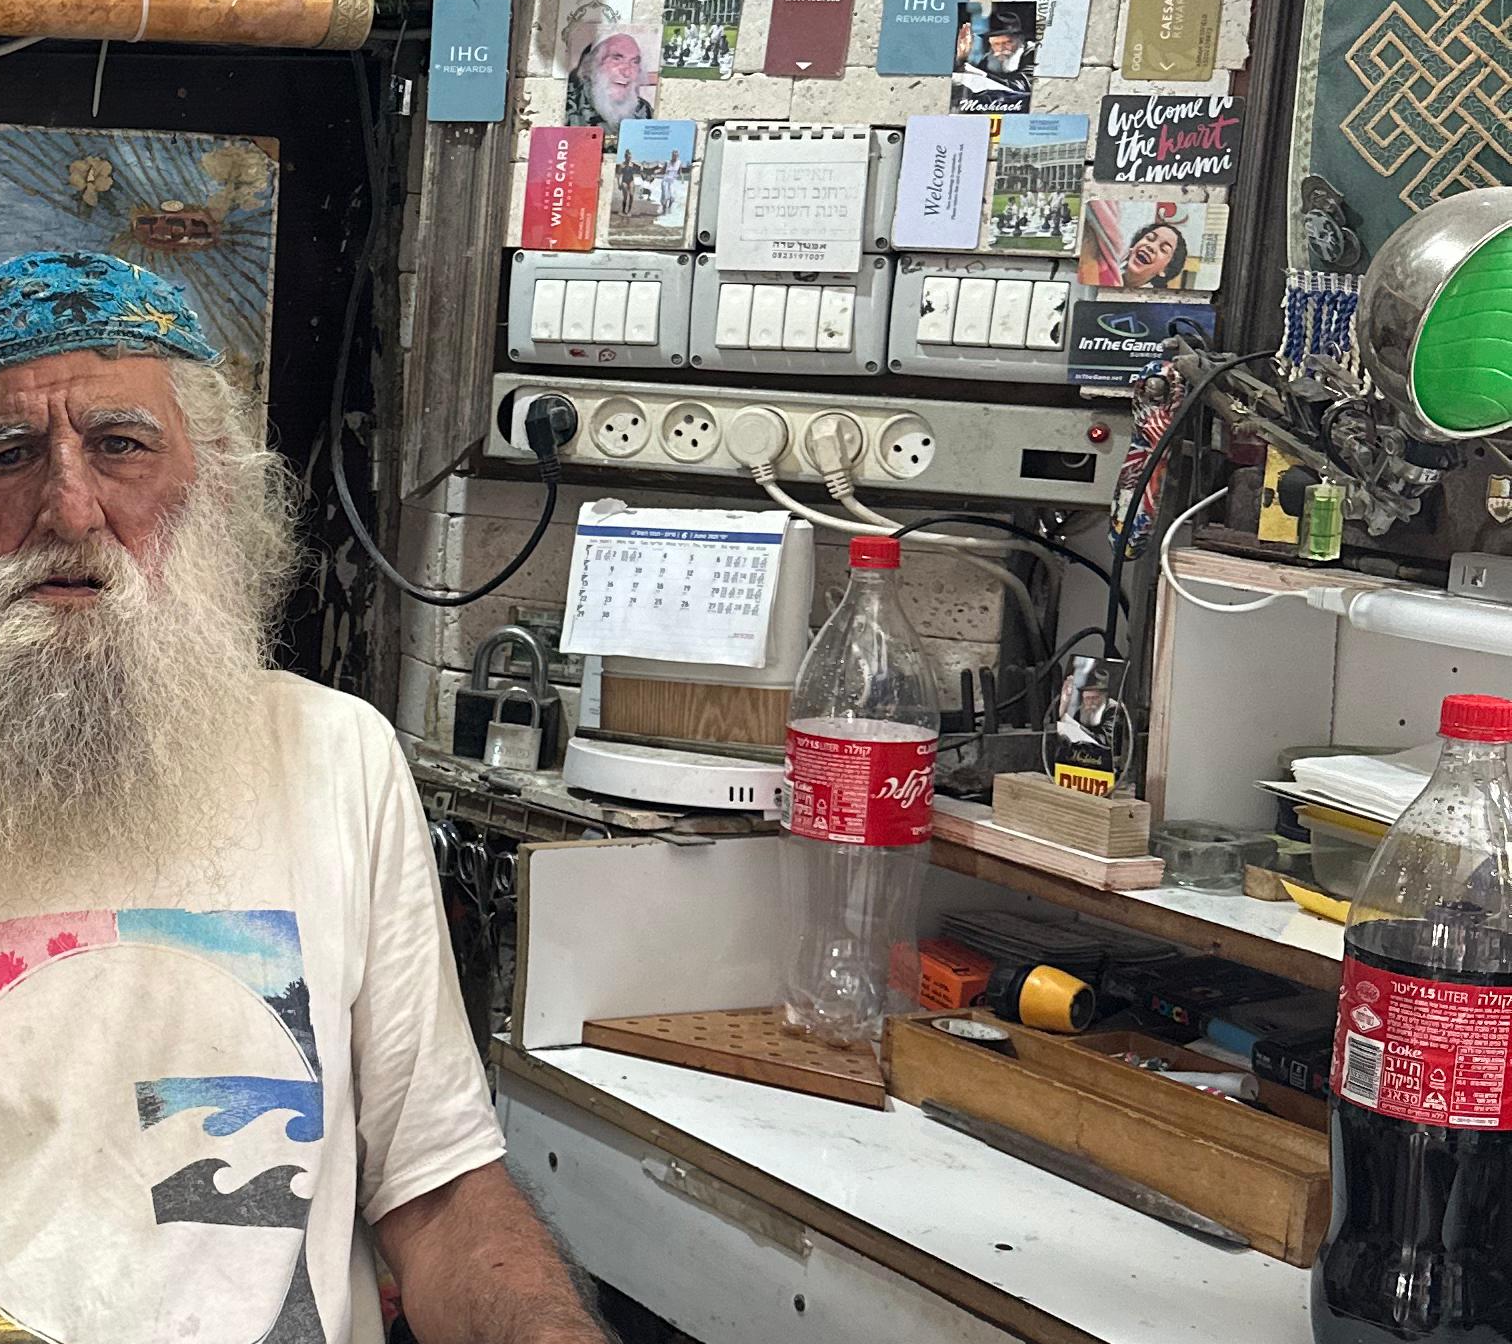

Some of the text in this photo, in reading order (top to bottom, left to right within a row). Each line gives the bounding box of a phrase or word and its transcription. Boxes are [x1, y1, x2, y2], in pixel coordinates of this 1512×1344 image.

[895, 14, 950, 24] REWARDS
[450, 46, 488, 61] IHG
[1131, 43, 1143, 72] GOLD
[443, 65, 493, 73] REWARDS
[1107, 95, 1204, 137] welcome
[1115, 114, 1239, 169] the heart
[1115, 148, 1233, 183] of miami
[550, 139, 569, 227] WILD CARD
[924, 144, 947, 217] Welcome
[1079, 337, 1164, 352] InTheGame
[844, 744, 871, 757] קולה
[1391, 981, 1419, 995] ליטר
[1420, 987, 1436, 999] 1.5
[1438, 990, 1468, 1004] LITER
[1388, 1041, 1423, 1058] Coke
[1386, 1057, 1421, 1076] חייב
[1383, 1072, 1420, 1090] בפיקדון
